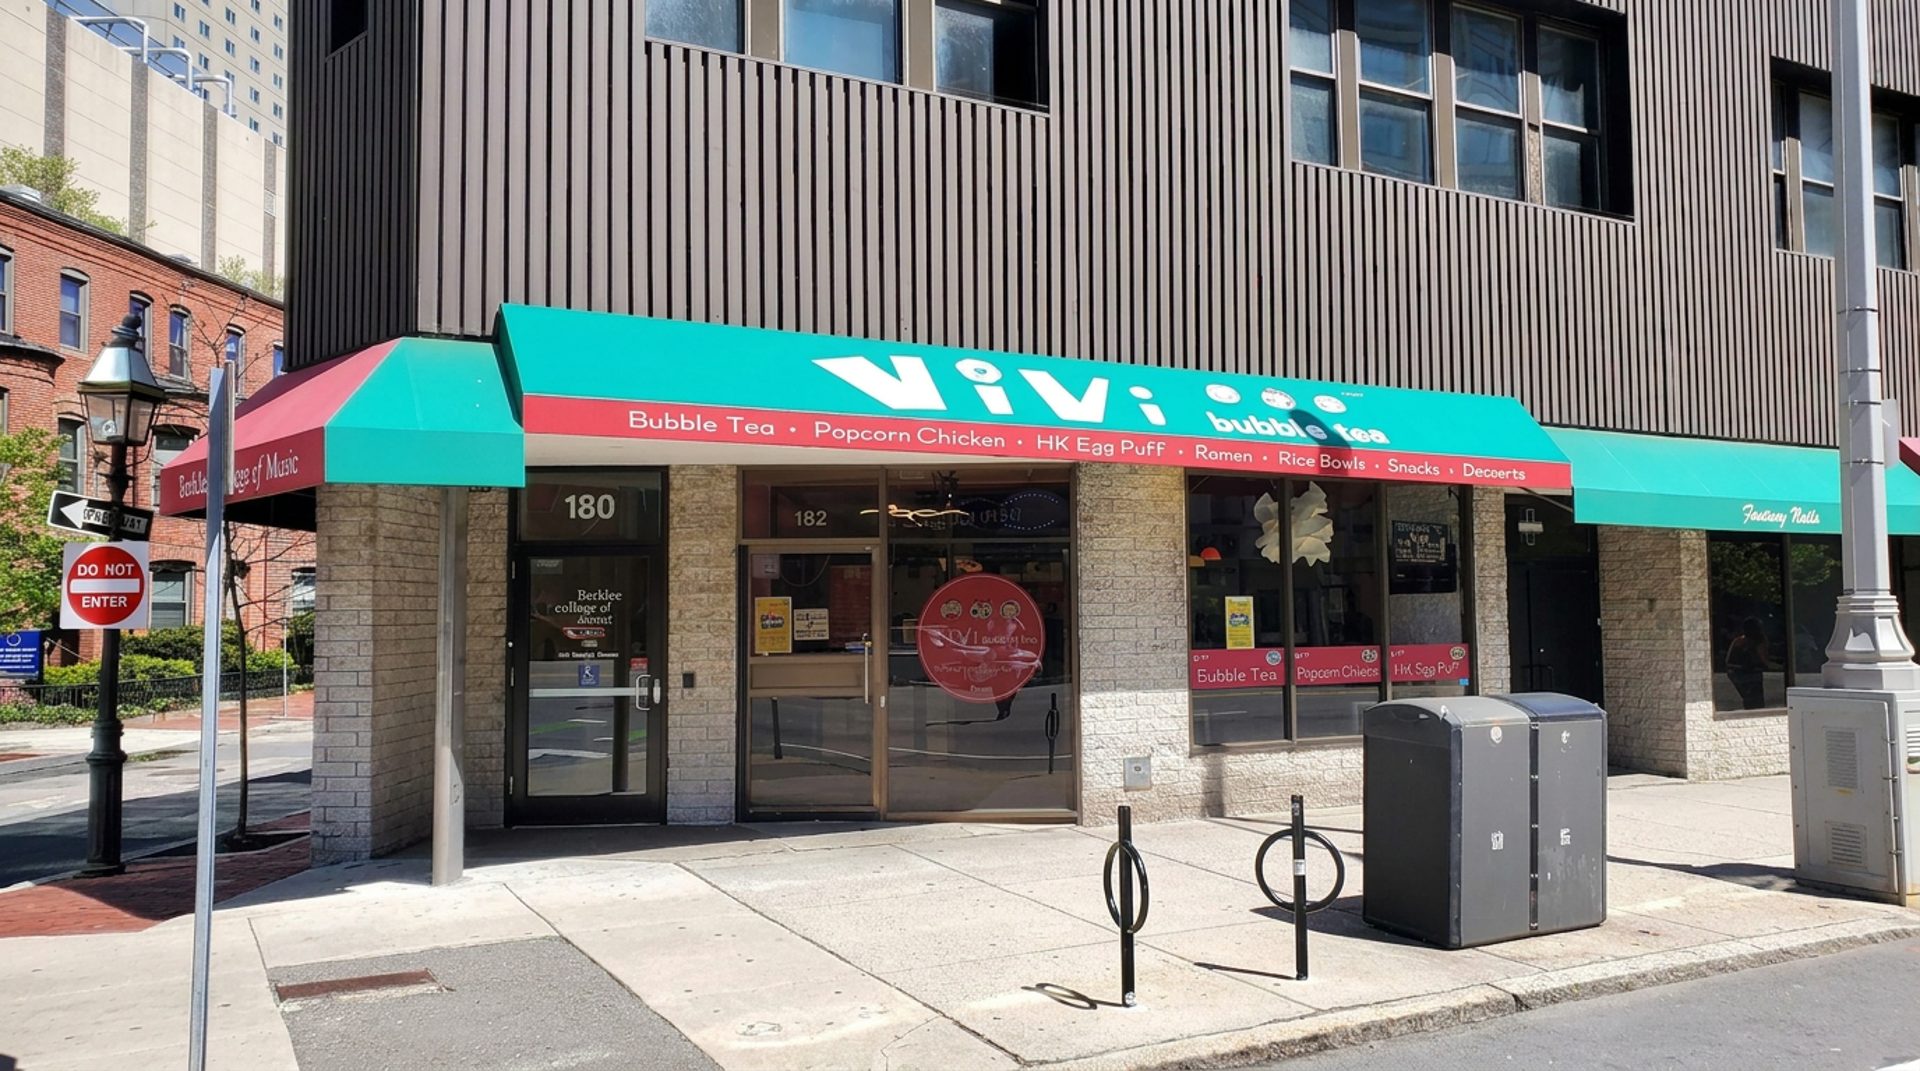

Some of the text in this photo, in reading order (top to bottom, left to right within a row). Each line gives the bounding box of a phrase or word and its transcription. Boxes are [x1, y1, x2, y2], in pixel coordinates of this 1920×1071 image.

[1333, 423, 1391, 445] tea
[628, 410, 718, 433] Bubble
[726, 416, 775, 436] Tea
[815, 420, 911, 445] Popcorn
[917, 426, 1006, 449] Chicken
[1036, 434, 1070, 451] HK
[1121, 439, 1167, 457] Puff
[1279, 451, 1316, 468] Rice
[1320, 454, 1366, 471] Bowls
[1387, 458, 1441, 477] Snacks
[564, 494, 616, 520] 180
[794, 510, 828, 527] 182
[77, 563, 135, 577] DO NOT
[81, 596, 128, 608] ENTER
[1250, 667, 1278, 682] Tea
